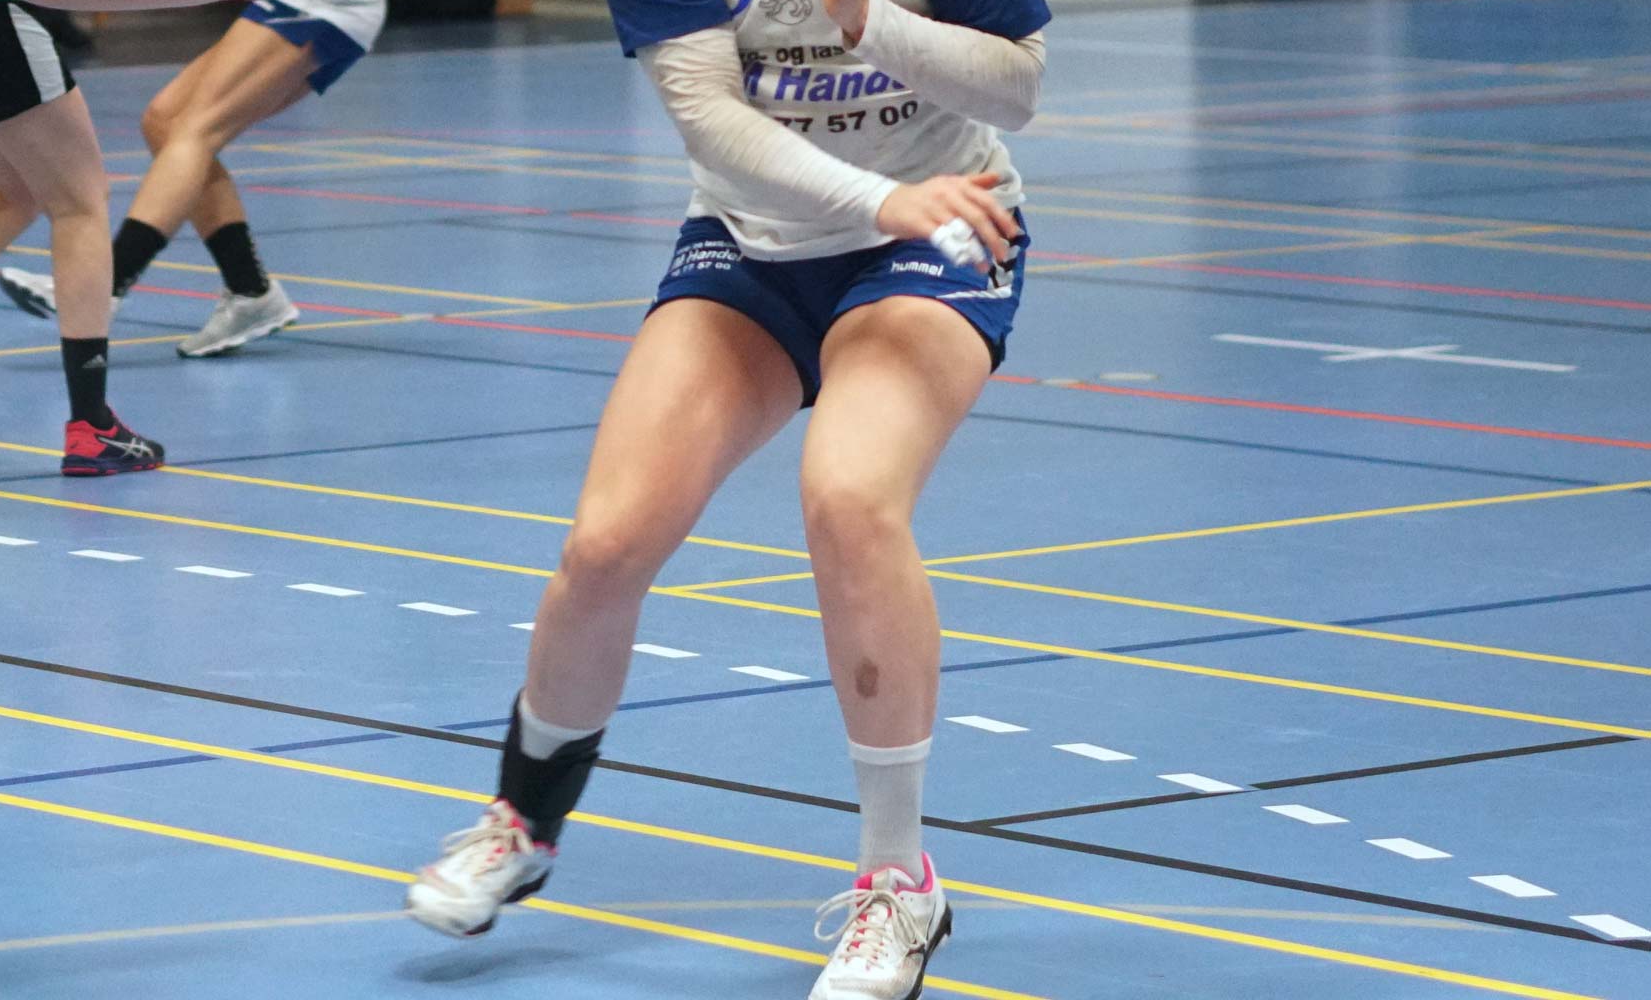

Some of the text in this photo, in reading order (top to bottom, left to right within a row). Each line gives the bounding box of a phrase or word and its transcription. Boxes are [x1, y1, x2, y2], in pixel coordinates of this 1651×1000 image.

[776, 45, 804, 65] og
[827, 110, 867, 134] 57
[879, 99, 919, 126] 00
[686, 249, 743, 264] Handel
[891, 261, 944, 278] hummel
